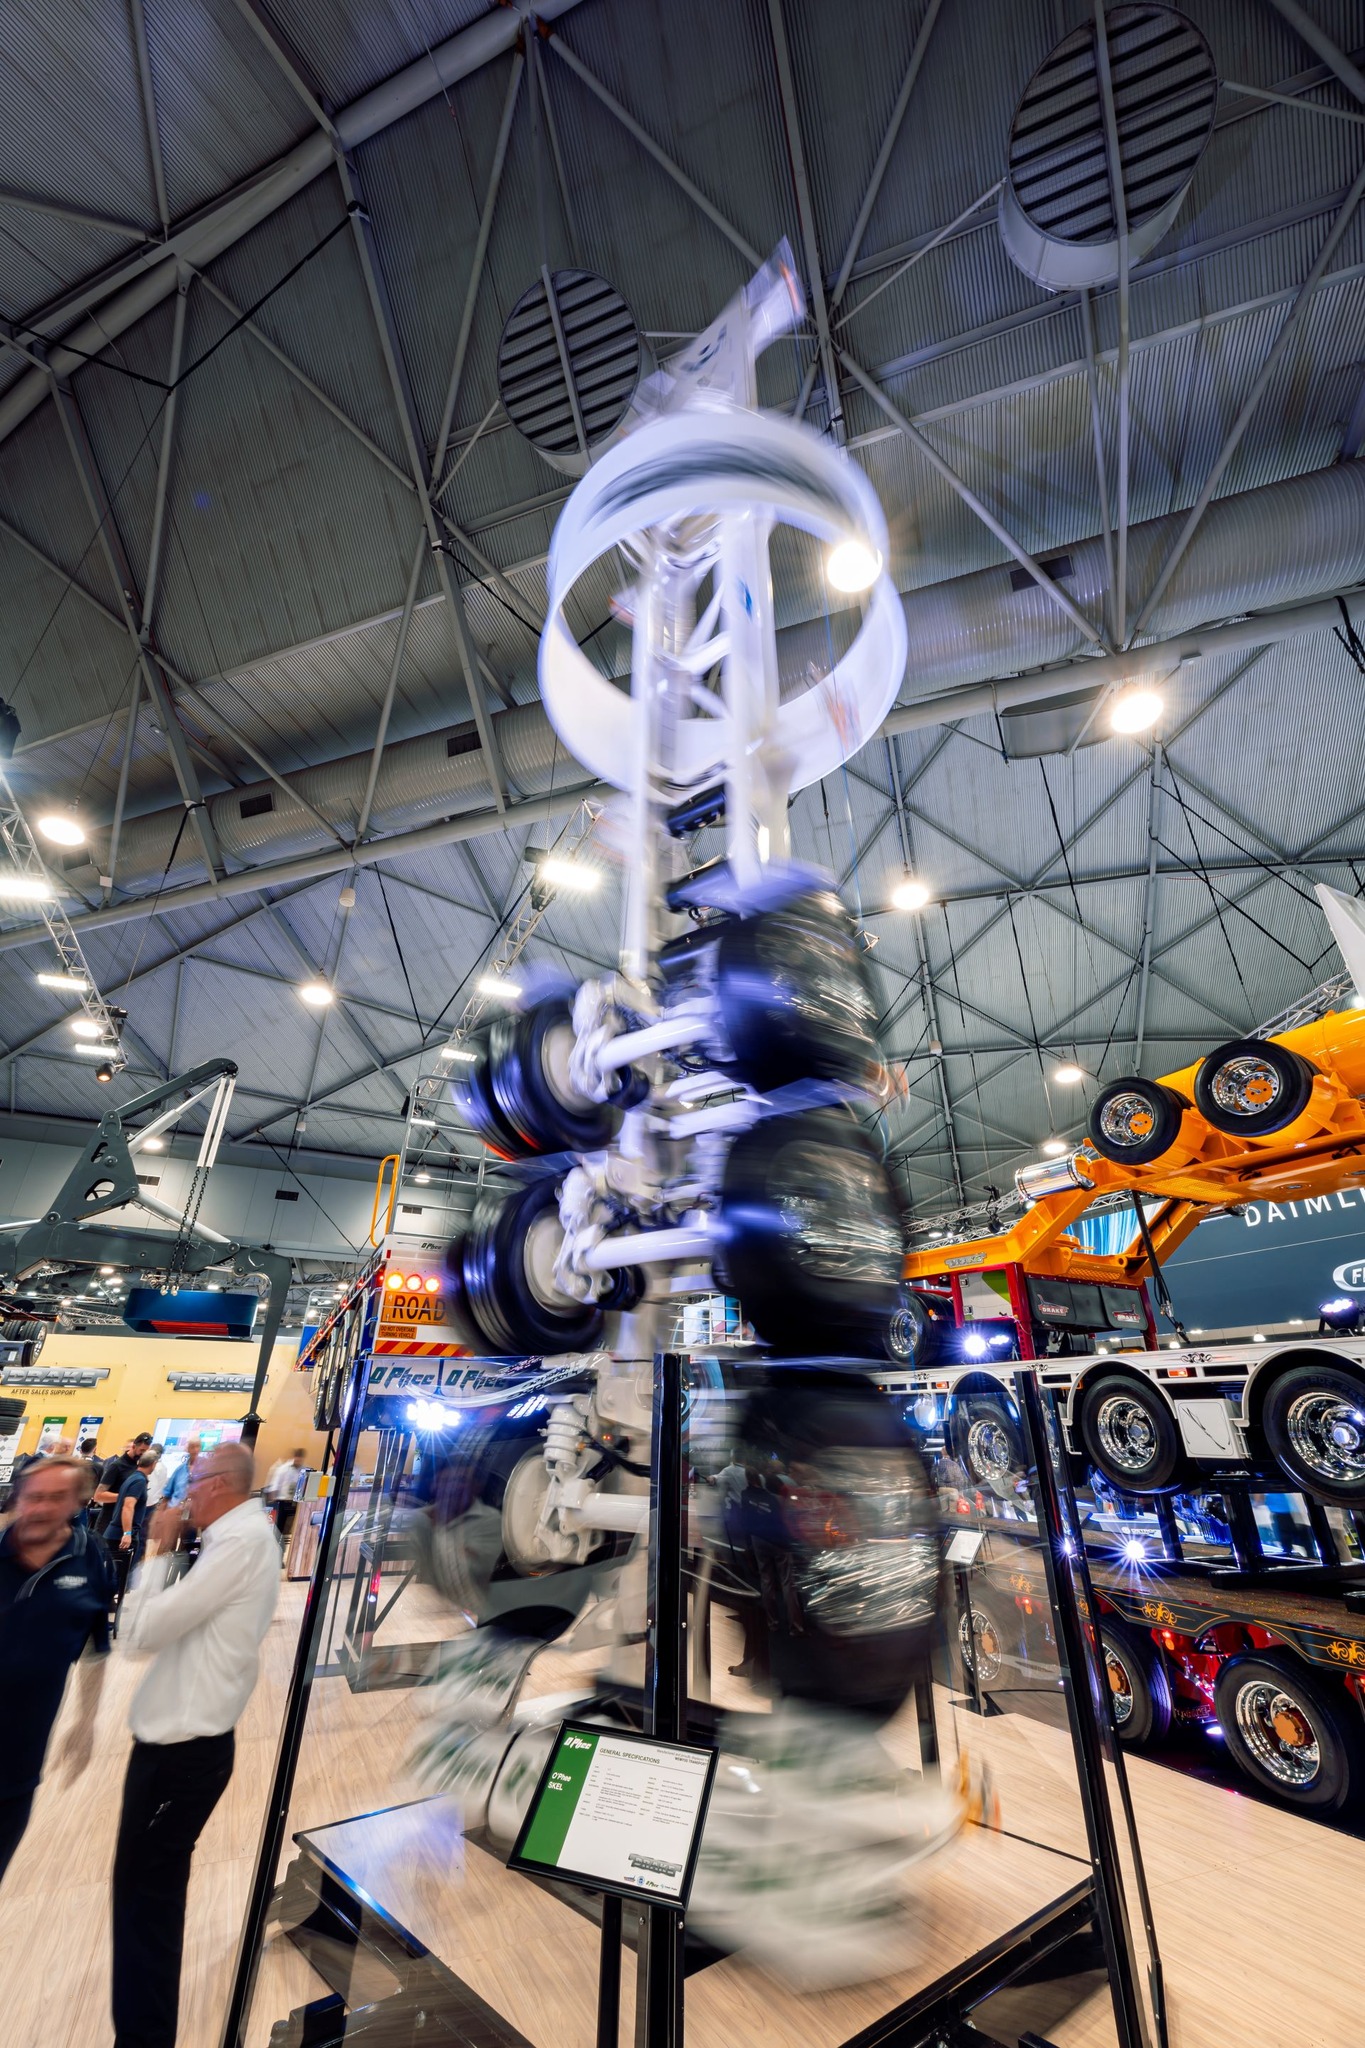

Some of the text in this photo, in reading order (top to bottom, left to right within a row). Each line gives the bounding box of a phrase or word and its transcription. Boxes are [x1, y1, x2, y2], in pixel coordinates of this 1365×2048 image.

[1244, 1187, 1365, 1227] DAIML
[1352, 1266, 1365, 1284] F
[392, 1294, 447, 1321] ROAD
[1042, 1306, 1065, 1314] DRAKE
[7, 1369, 96, 1384] DRAKE
[179, 1374, 256, 1389] DRAKE
[368, 1362, 435, 1390] O'Phee
[599, 1747, 621, 1757] GENERAL
[622, 1751, 660, 1765] SPECIFICATIONS
[552, 1771, 572, 1782] O'Phee
[548, 1781, 563, 1791] SKEL
